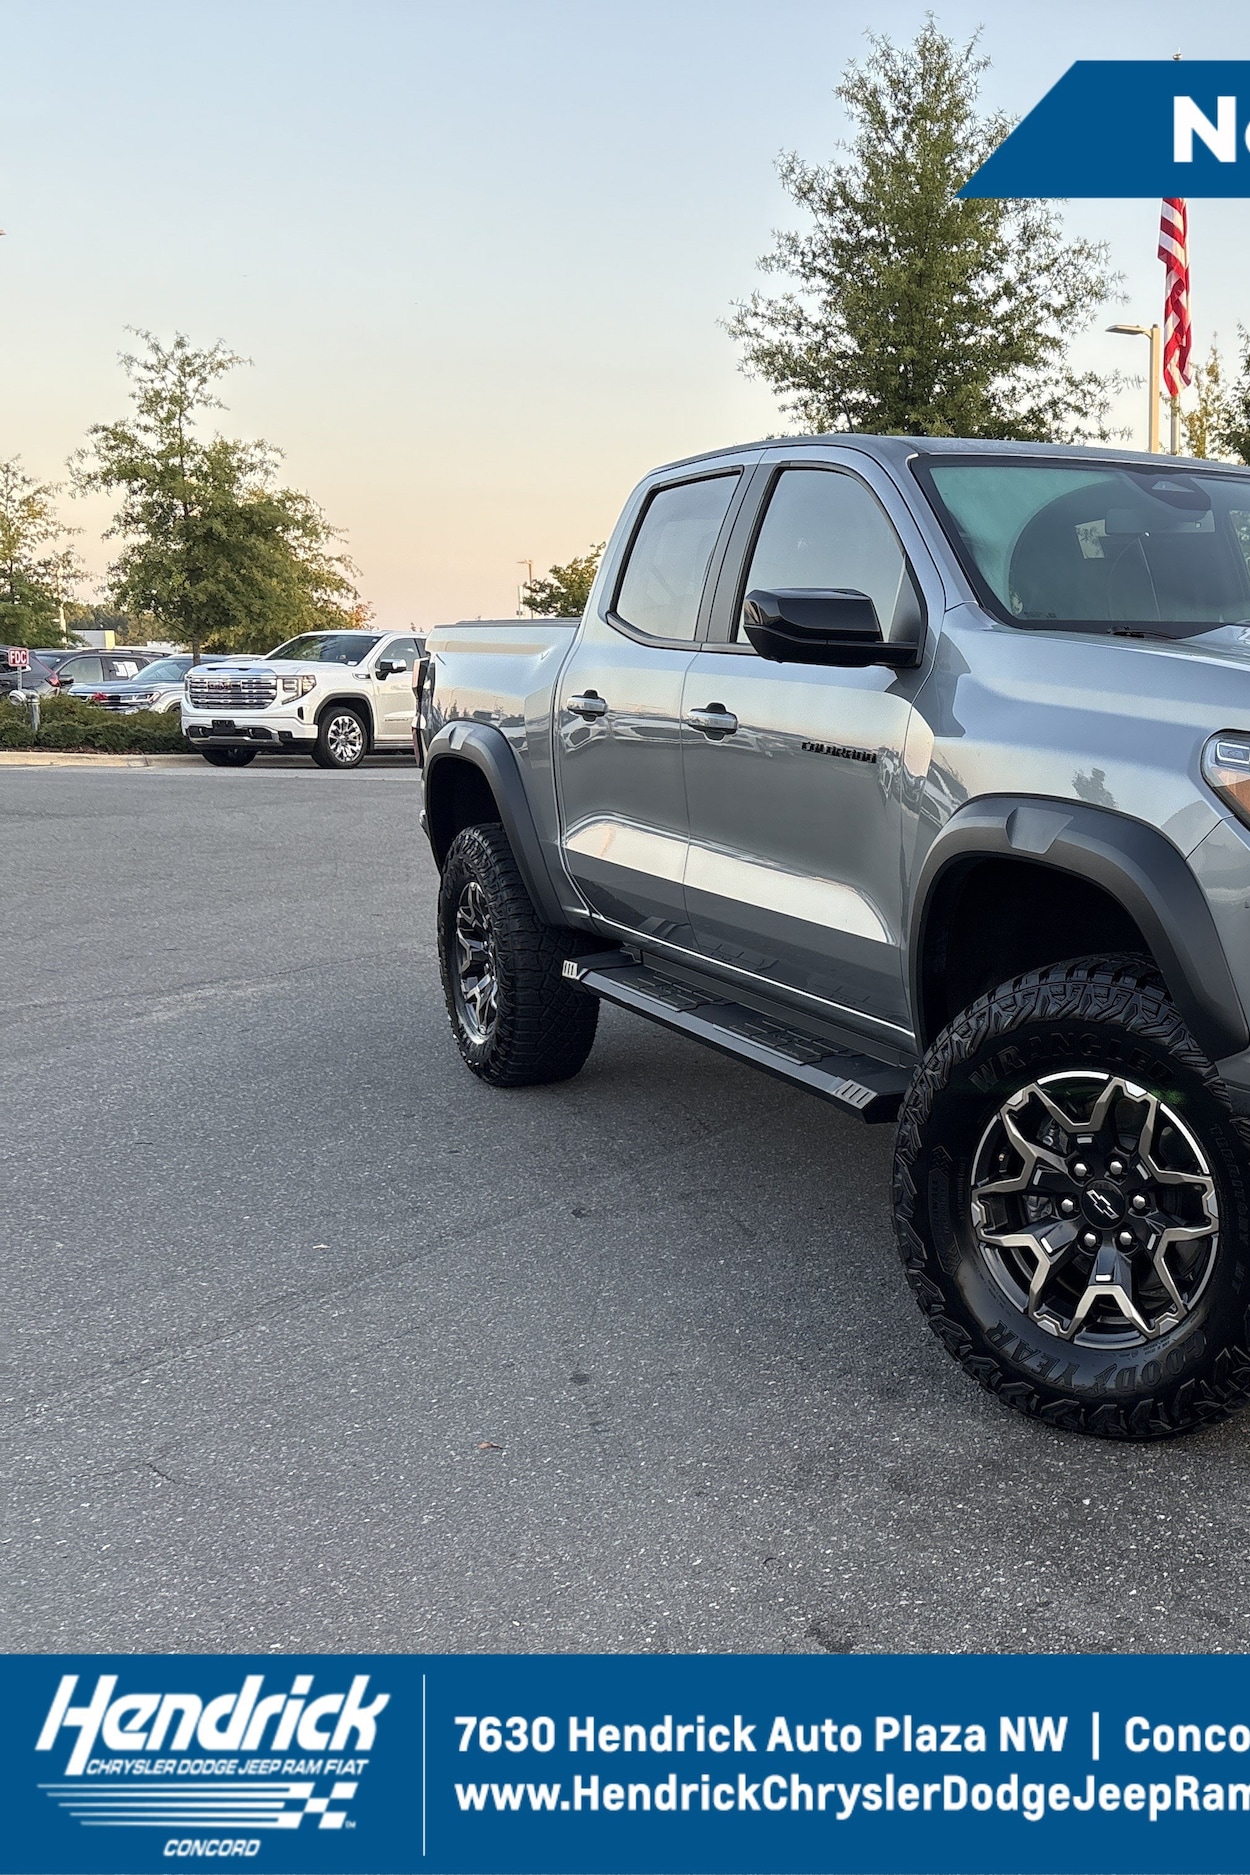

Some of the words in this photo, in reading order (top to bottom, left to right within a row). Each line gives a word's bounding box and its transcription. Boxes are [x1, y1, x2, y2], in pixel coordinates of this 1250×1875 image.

[10, 650, 27, 664] FDC
[968, 1032, 1174, 1093] WRANGLER
[985, 1320, 1207, 1397] GOODYEAR
